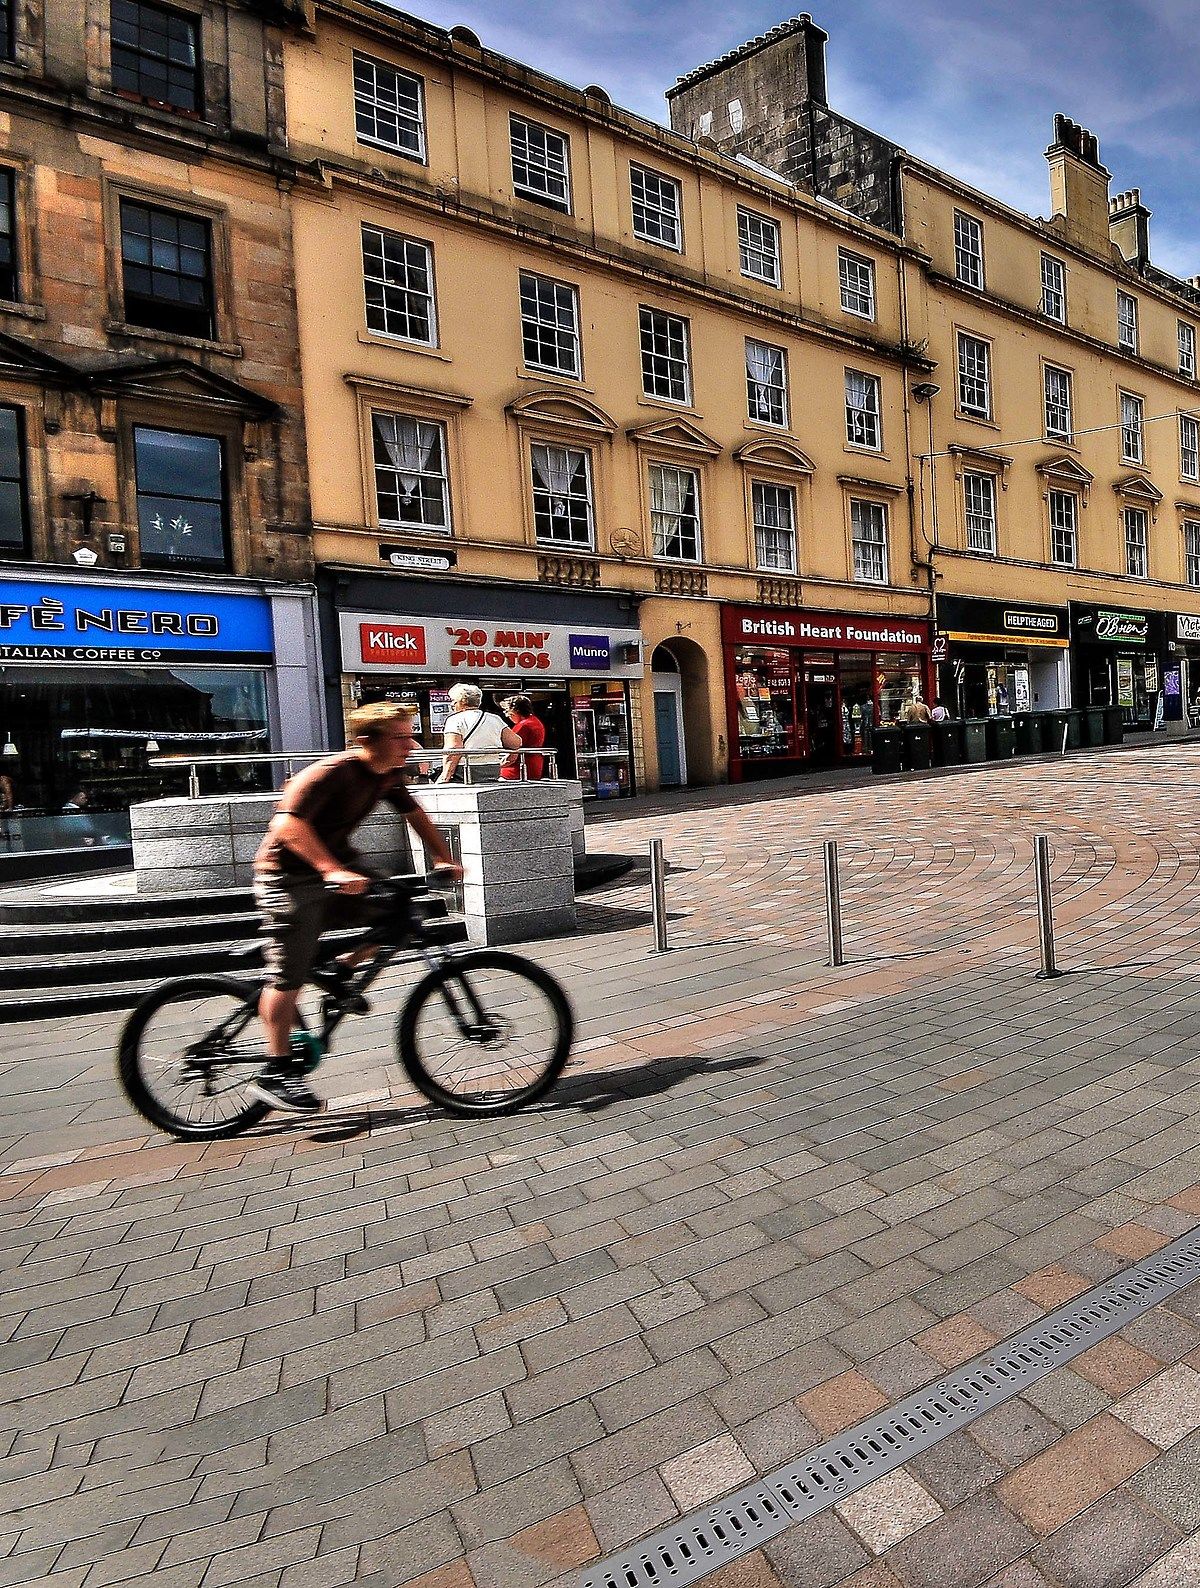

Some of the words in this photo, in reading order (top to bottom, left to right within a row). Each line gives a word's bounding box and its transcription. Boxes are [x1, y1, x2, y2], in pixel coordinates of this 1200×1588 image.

[76, 608, 219, 636] NERO
[741, 619, 795, 636] British
[800, 623, 842, 640] Heart
[846, 627, 922, 644] Foundation
[370, 631, 418, 650] Klick
[73, 648, 135, 660] COFFEE
[450, 649, 550, 669] PHOTOS
[573, 645, 608, 658] Munro
